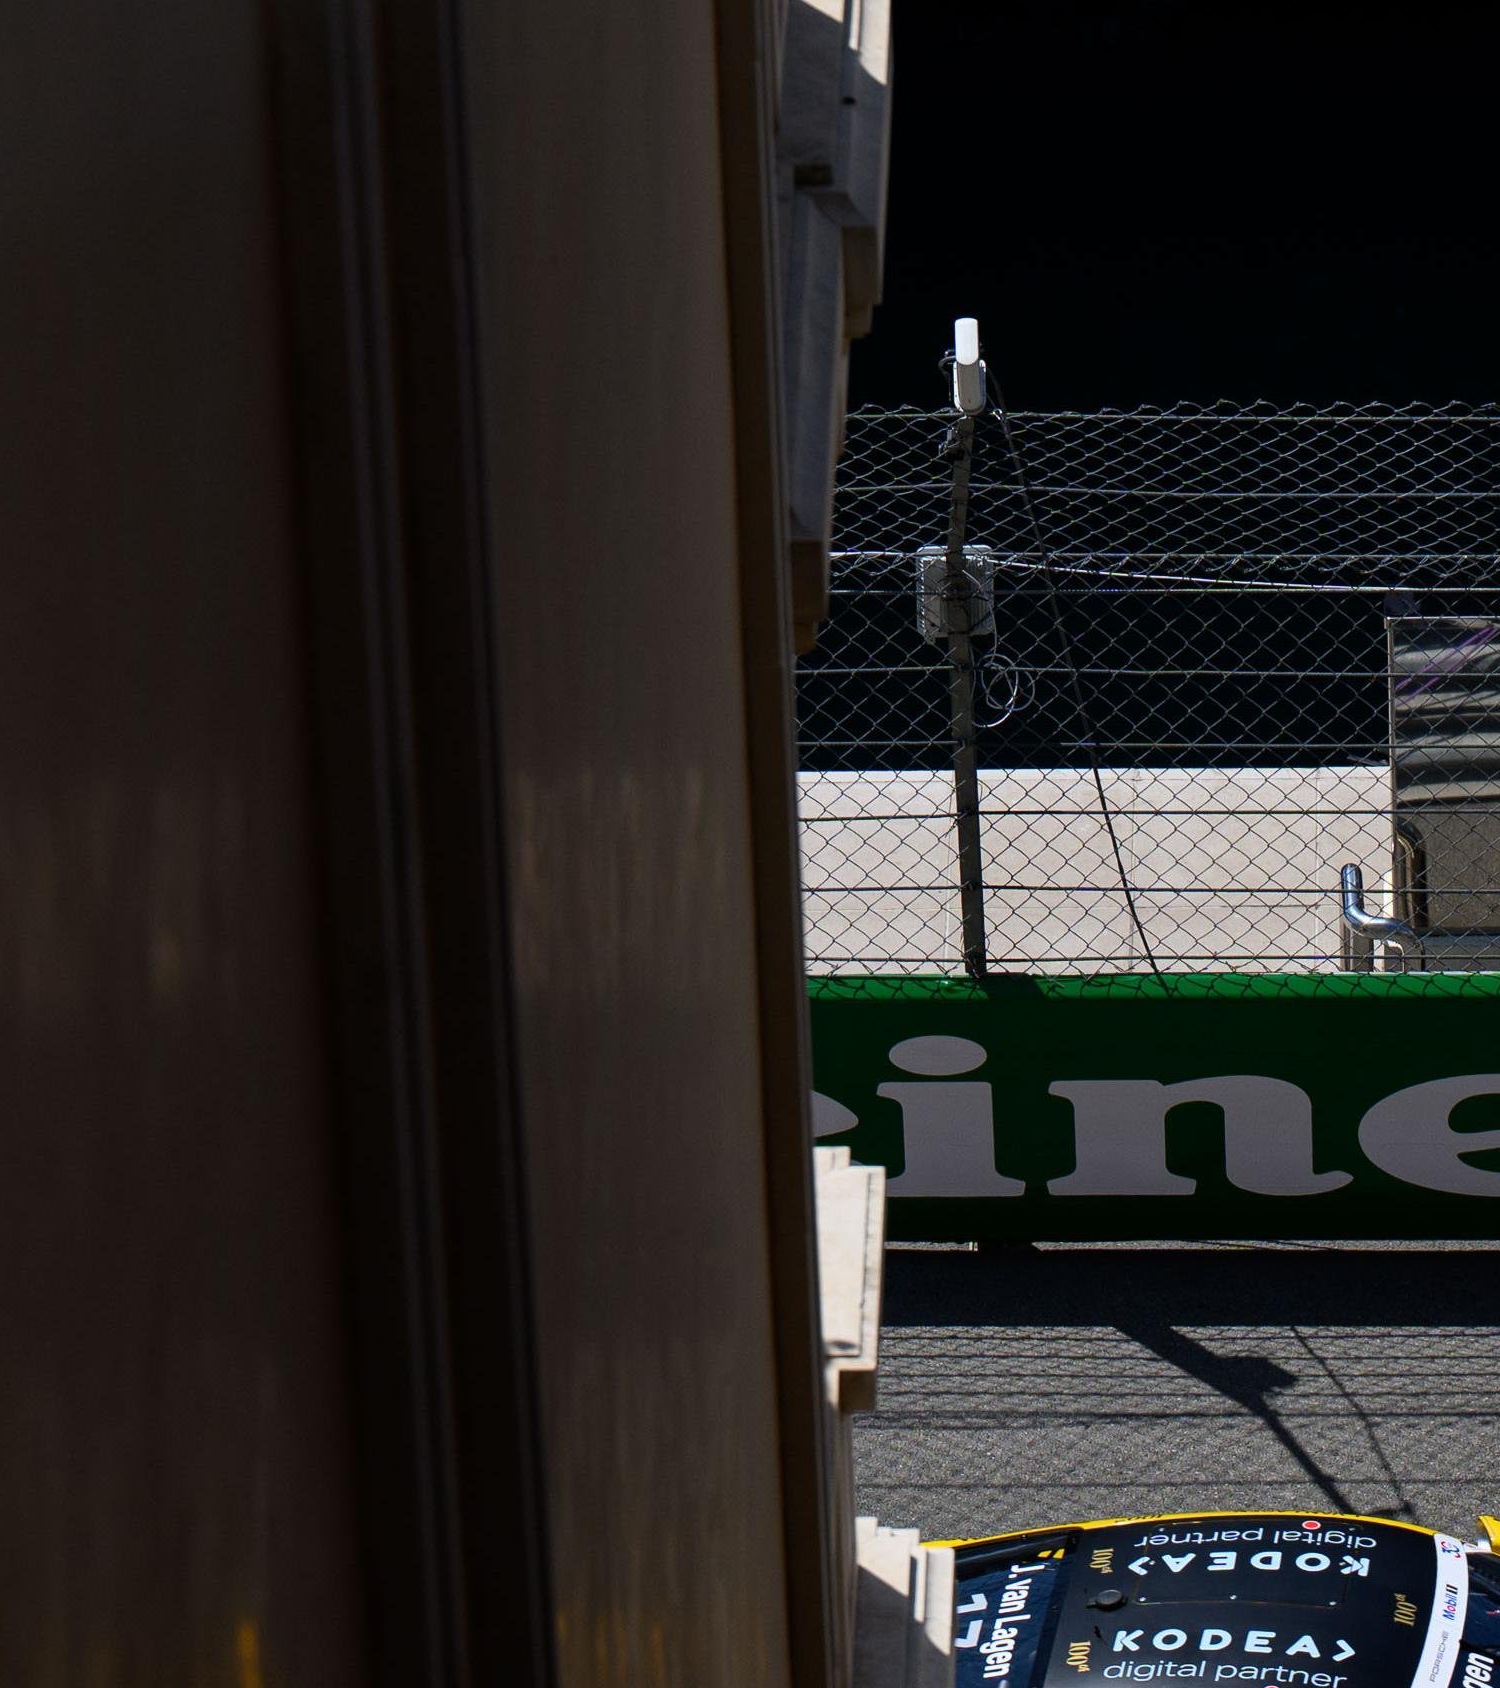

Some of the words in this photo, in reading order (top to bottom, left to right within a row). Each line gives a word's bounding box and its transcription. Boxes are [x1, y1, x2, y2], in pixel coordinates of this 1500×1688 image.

[1133, 1527, 1264, 1549] partner
[1273, 1527, 1378, 1549] digital
[1008, 1564, 1045, 1580] J.
[1161, 1551, 1371, 1577] KODEA
[997, 1578, 1033, 1615] van
[1442, 1593, 1458, 1622] Mobil
[979, 1613, 1032, 1679] Lagen
[1112, 1628, 1322, 1659] KODEA
[1103, 1659, 1206, 1682] digital
